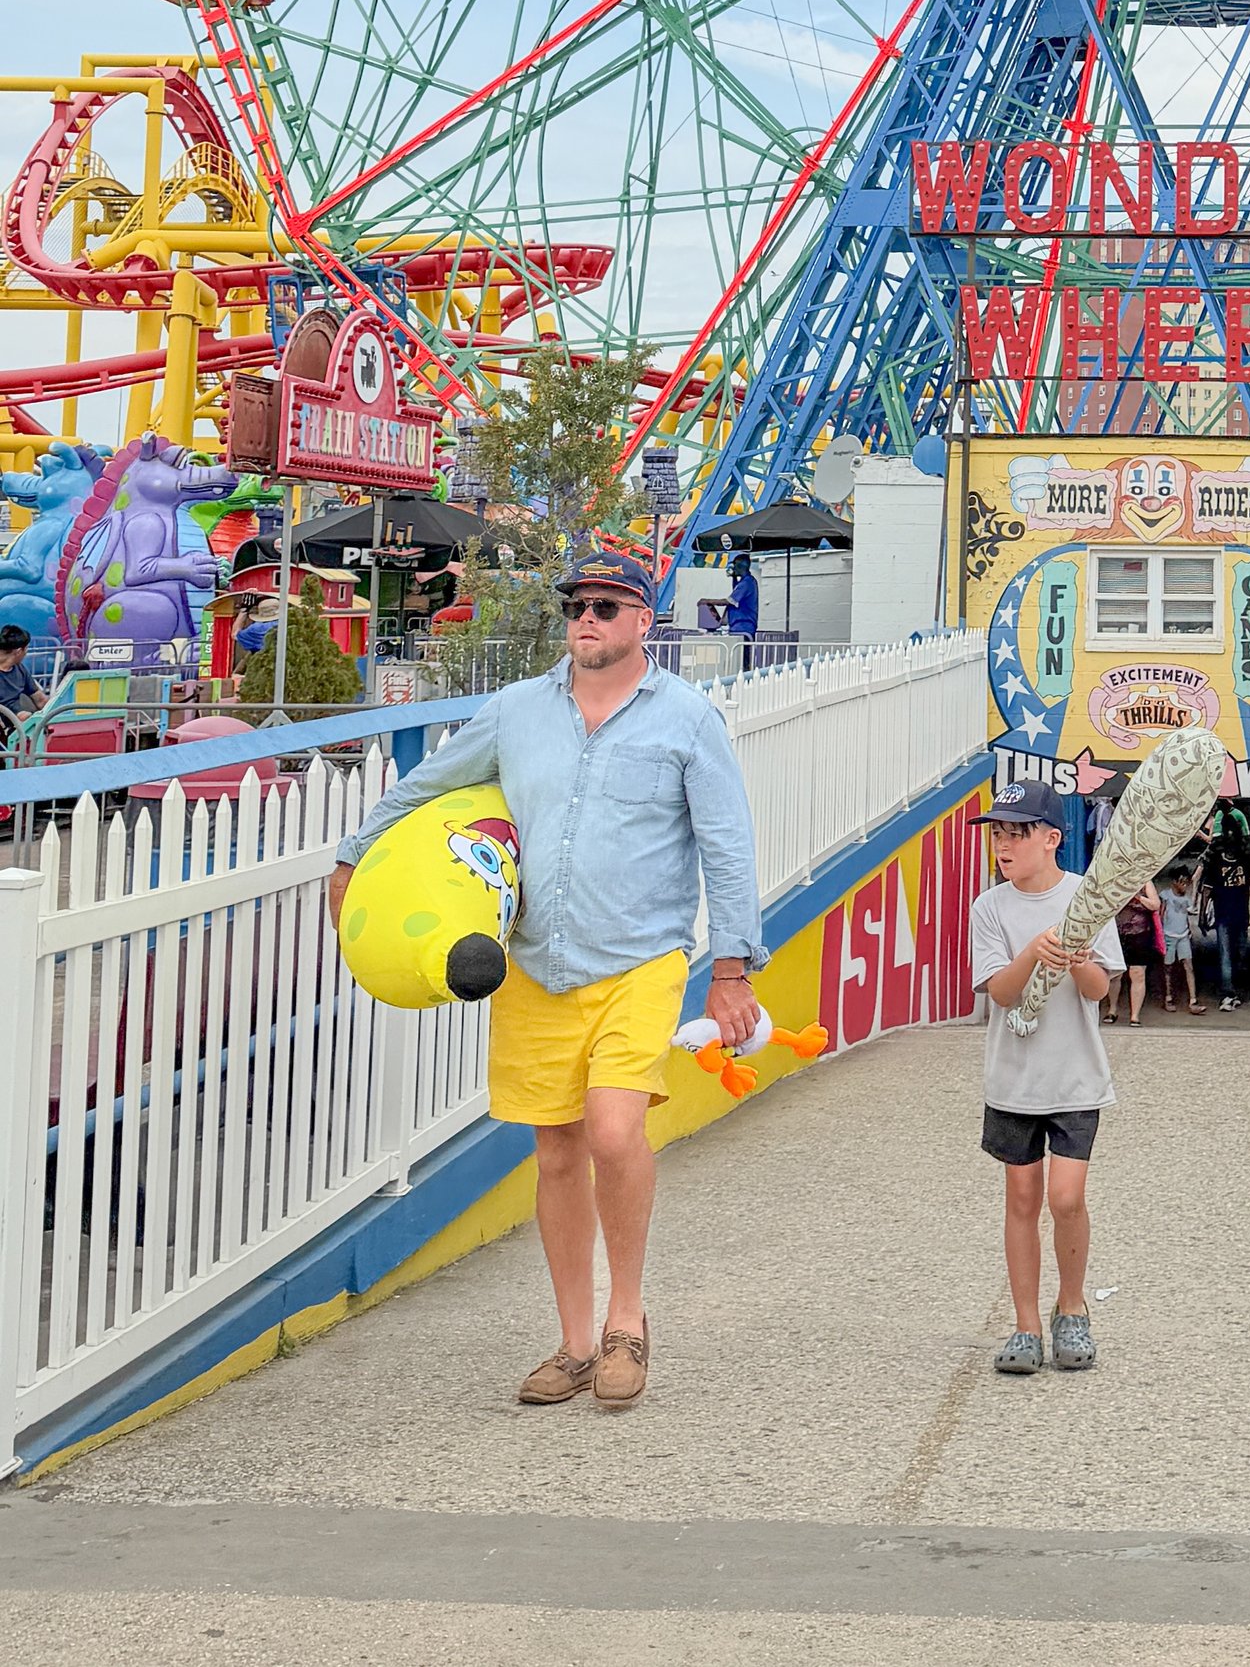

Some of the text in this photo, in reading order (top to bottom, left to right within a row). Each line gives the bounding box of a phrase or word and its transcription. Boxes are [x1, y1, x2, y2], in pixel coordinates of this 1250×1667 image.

[298, 402, 427, 469] TRAIN STATION
[1047, 484, 1107, 514] MORE
[1046, 585, 1067, 675] FUN
[99, 646, 123, 654] Enter
[1109, 668, 1204, 687] EXCITEMENT
[1120, 705, 1187, 728] THRILLS
[993, 747, 1077, 795] THIS
[819, 791, 982, 1057] ISLAND
